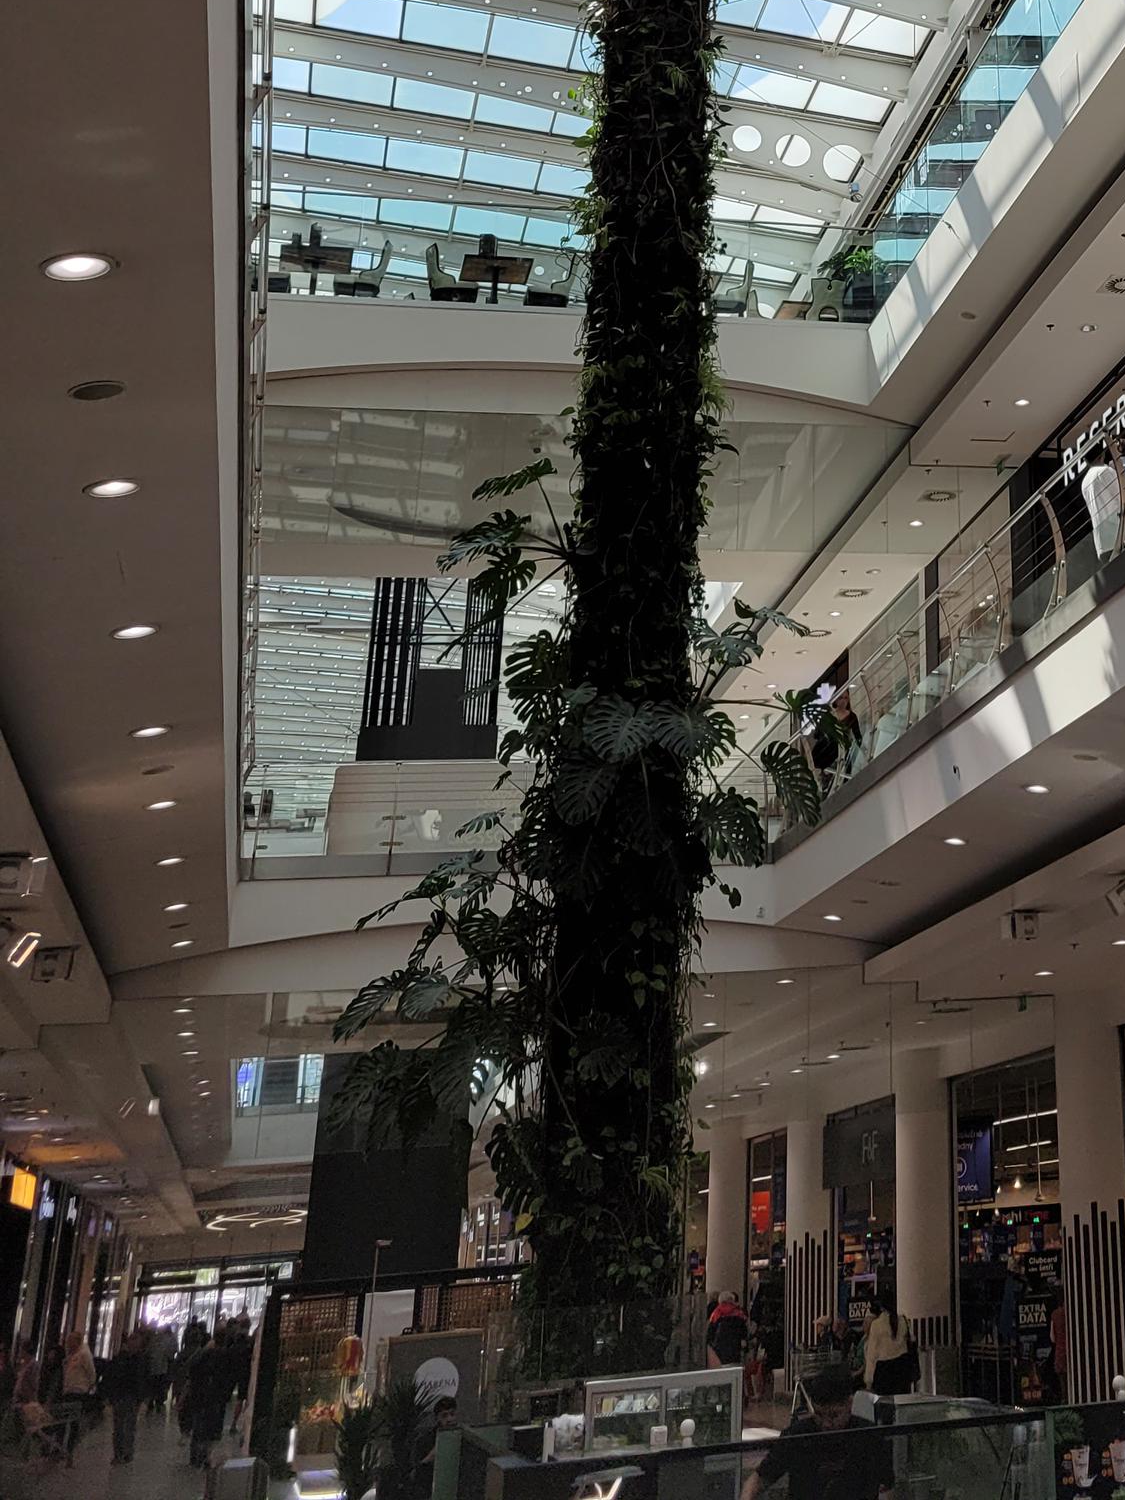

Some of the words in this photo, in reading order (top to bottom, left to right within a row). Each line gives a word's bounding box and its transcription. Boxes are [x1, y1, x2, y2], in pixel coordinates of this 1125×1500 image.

[1028, 1255, 1058, 1265] Clubcard
[849, 1301, 872, 1310] EXTRA
[1018, 1303, 1047, 1314] EXTRA
[1019, 1312, 1047, 1325] DATA
